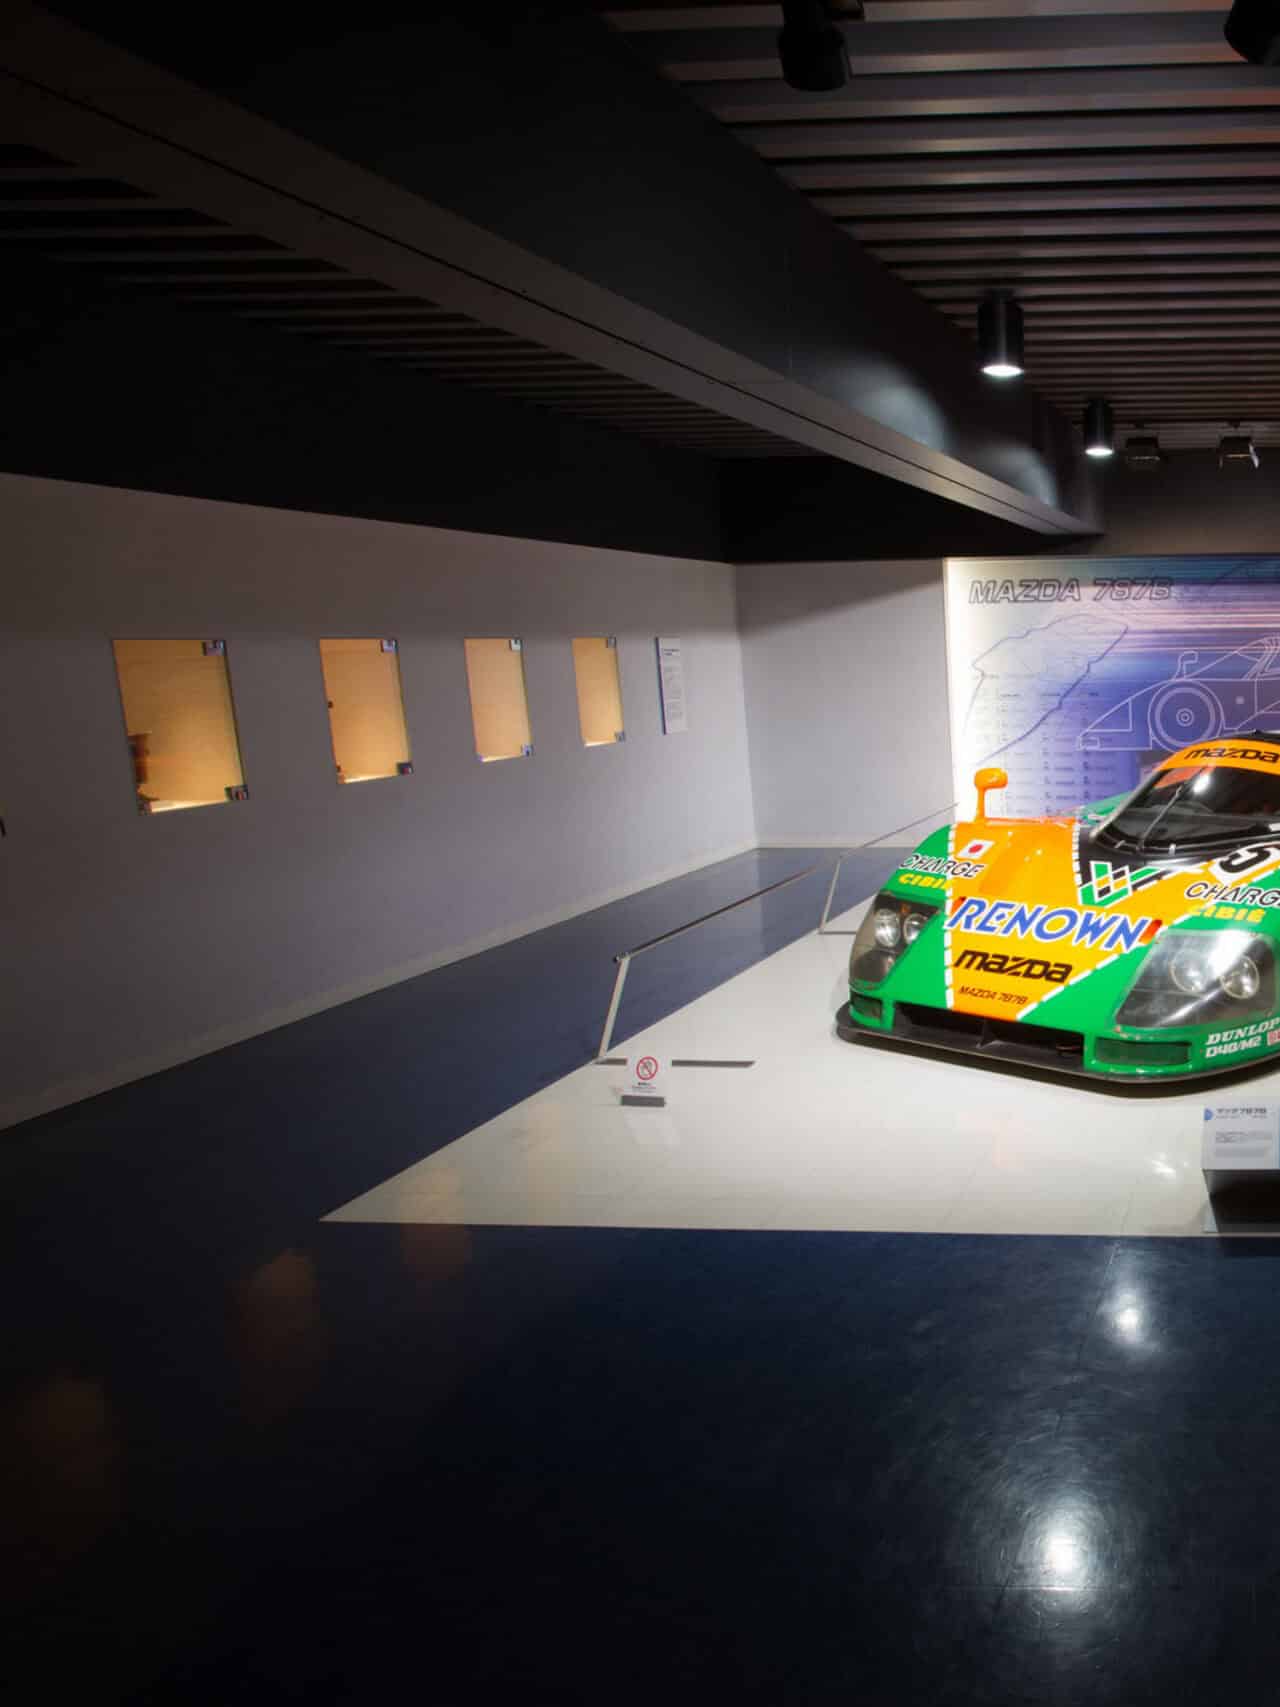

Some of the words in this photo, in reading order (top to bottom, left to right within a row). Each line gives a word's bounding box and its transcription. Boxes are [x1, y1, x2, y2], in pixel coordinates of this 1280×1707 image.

[968, 578, 1081, 604] MAZDA
[1093, 577, 1174, 601] 787B
[899, 853, 985, 878] CHARGE
[947, 898, 1148, 951] RENOWN
[959, 985, 997, 1000] MAZDA
[998, 993, 1028, 1005] 787B
[1205, 1017, 1280, 1046] DUNLOP
